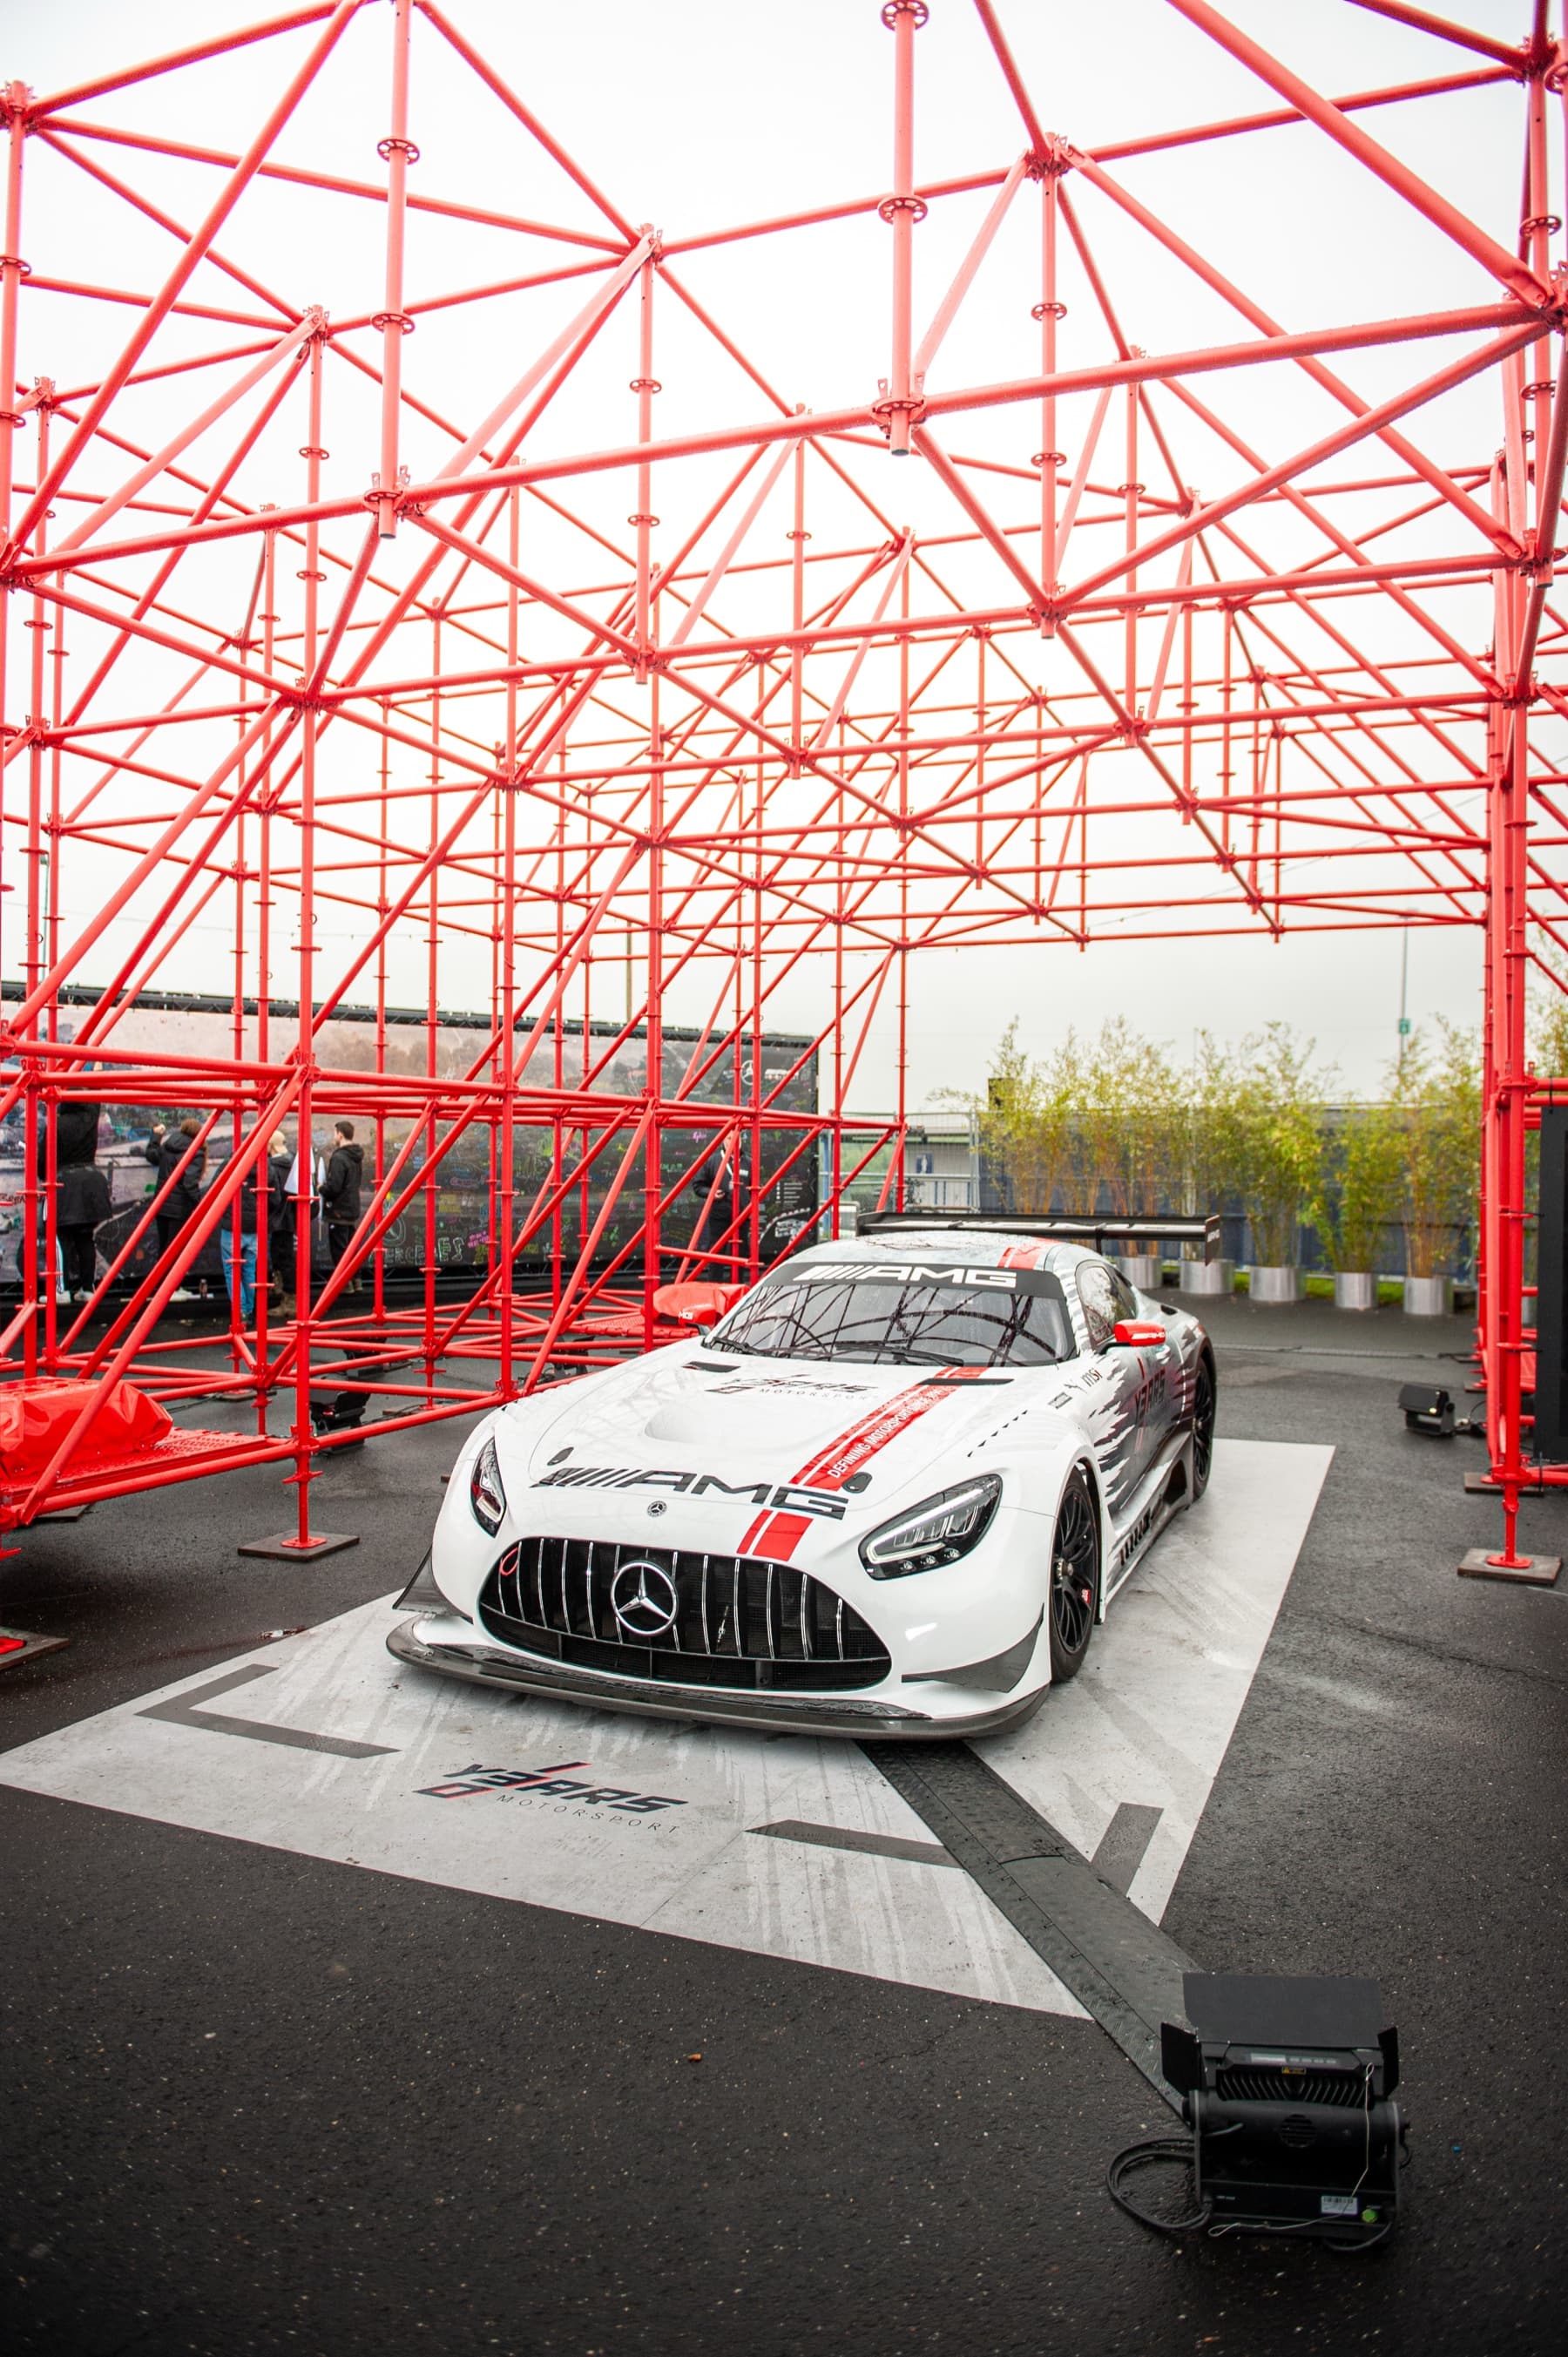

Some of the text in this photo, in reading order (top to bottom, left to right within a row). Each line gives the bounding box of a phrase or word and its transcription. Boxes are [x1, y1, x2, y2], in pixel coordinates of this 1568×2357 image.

[759, 1388, 879, 1401] MOTORSPOR
[828, 1441, 872, 1479] DEFINING
[864, 1405, 914, 1446] MOTORSPORT
[496, 1793, 680, 1833] MOTORSPORT
